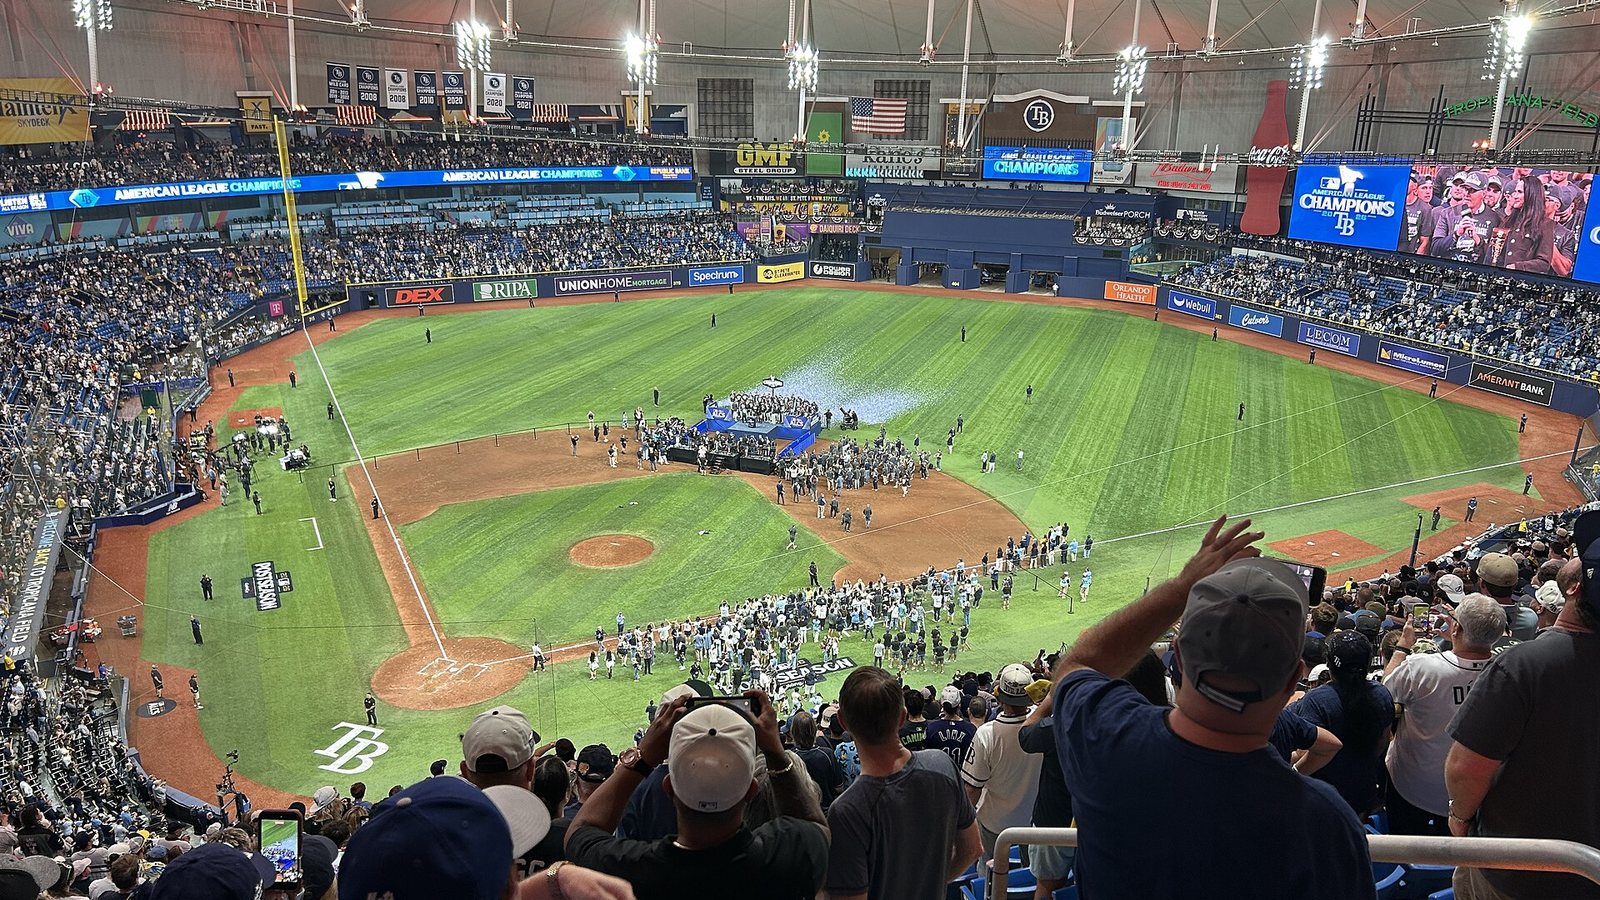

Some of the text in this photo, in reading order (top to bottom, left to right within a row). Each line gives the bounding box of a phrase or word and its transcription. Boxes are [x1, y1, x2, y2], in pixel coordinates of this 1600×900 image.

[0, 96, 78, 125] aintenX
[1444, 94, 1543, 119] TROPIANA
[17, 118, 50, 128] SKYDECK
[1030, 106, 1049, 126] TB
[736, 142, 793, 166] GMF
[443, 168, 603, 182] AMERICAN LEAGUE CHAMPIONS
[994, 161, 1079, 176] CHAMPIONS
[115, 186, 181, 200] AMERICAN
[182, 183, 230, 196] LEAGUE
[1312, 189, 1385, 200] AMERICAN LEAGUE
[1299, 194, 1395, 217] CHAMPIONS
[1124, 210, 1151, 219] PORCH
[7, 224, 34, 236] VIVA
[820, 224, 860, 233] DAIQUIRI DECK
[1333, 212, 1354, 236] TB
[693, 271, 735, 282] Spectrum
[395, 287, 445, 304] DEX
[494, 282, 532, 298] RIPA
[1113, 284, 1150, 294] ORLANDO
[1116, 291, 1145, 302] HEALTH
[1185, 299, 1211, 314] Webull
[1241, 313, 1270, 326] Culver's
[1306, 327, 1351, 346] LECOM
[1477, 373, 1545, 396] AMERANT BANK
[12, 518, 59, 643] WELCOME BACK TO TROPICANA FIELD
[254, 562, 278, 610] POSTSEASON
[313, 721, 390, 775] TB
